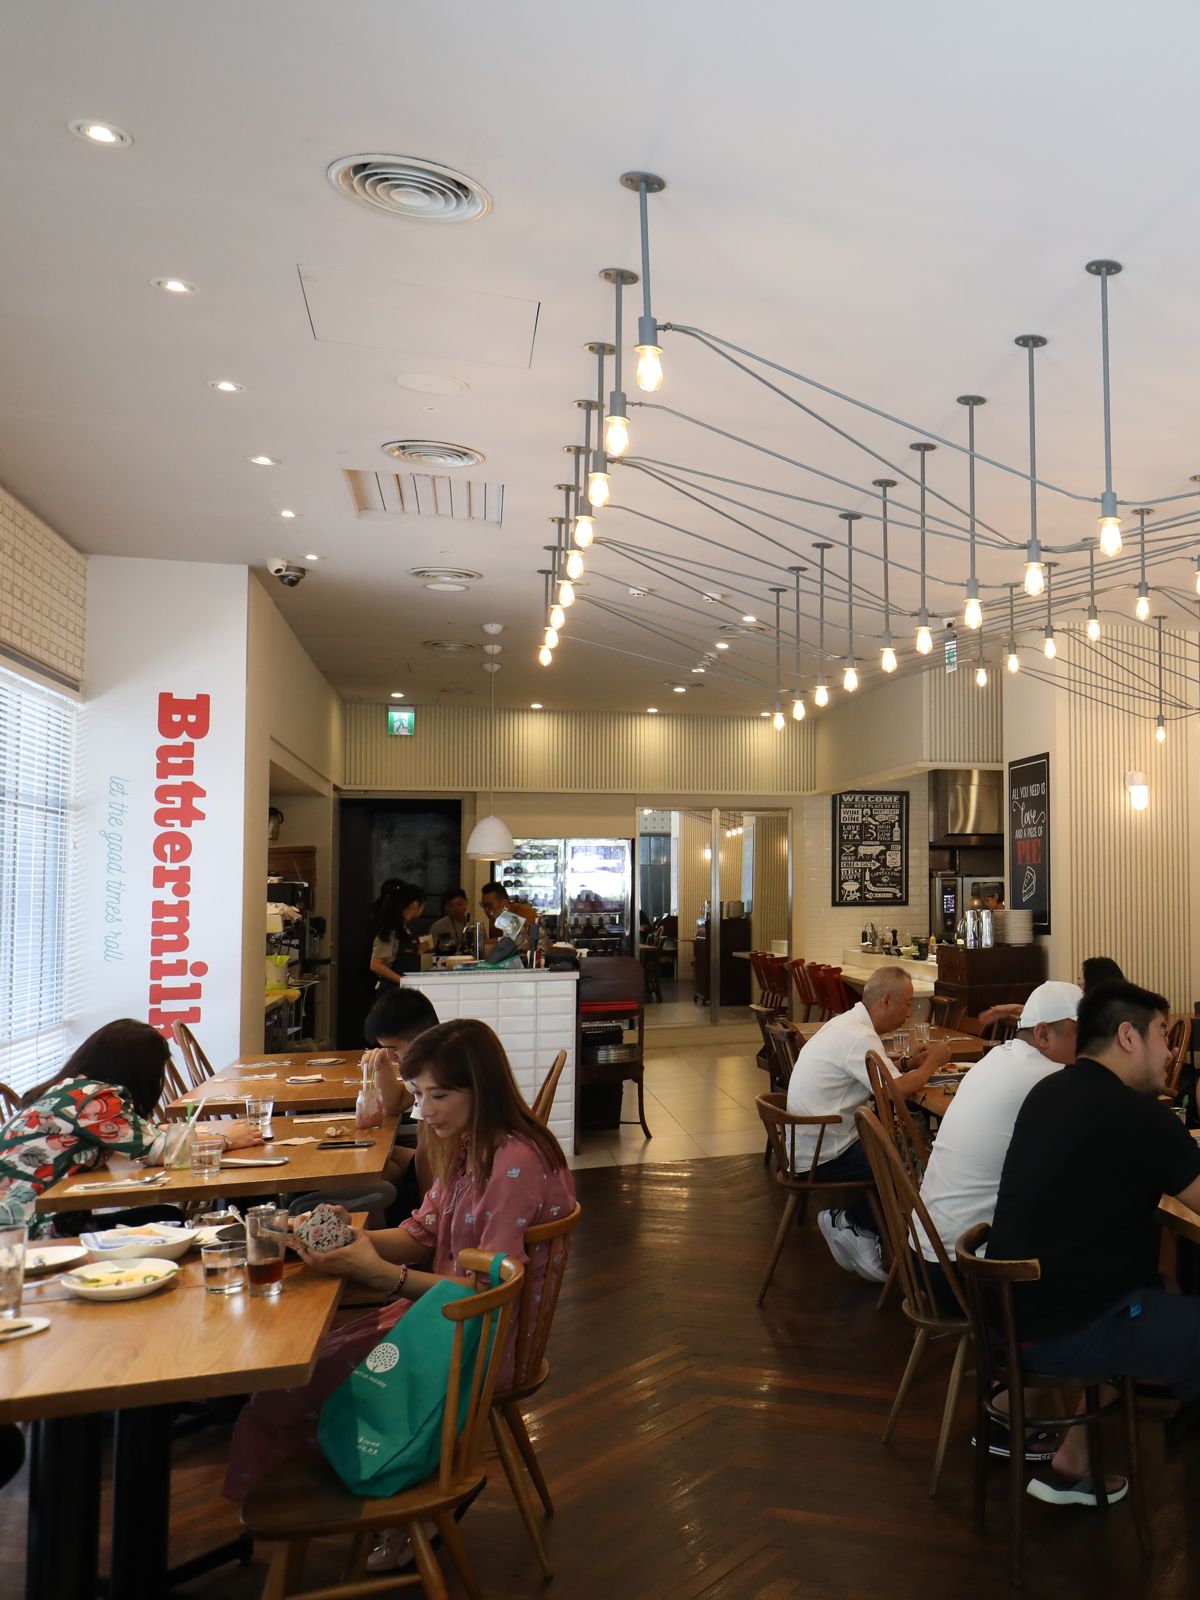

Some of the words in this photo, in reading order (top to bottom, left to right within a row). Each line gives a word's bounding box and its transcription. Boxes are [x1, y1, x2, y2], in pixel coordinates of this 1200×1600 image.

[109, 776, 130, 797] let
[842, 794, 900, 803] WELCOME
[1020, 786, 1029, 798] YOU
[1030, 784, 1040, 797] NEED
[1041, 782, 1045, 795] IS
[108, 801, 129, 827] the
[99, 829, 127, 876] good
[1016, 838, 1042, 865] PIE
[148, 691, 211, 1046] Buttermilk
[105, 880, 127, 923] times
